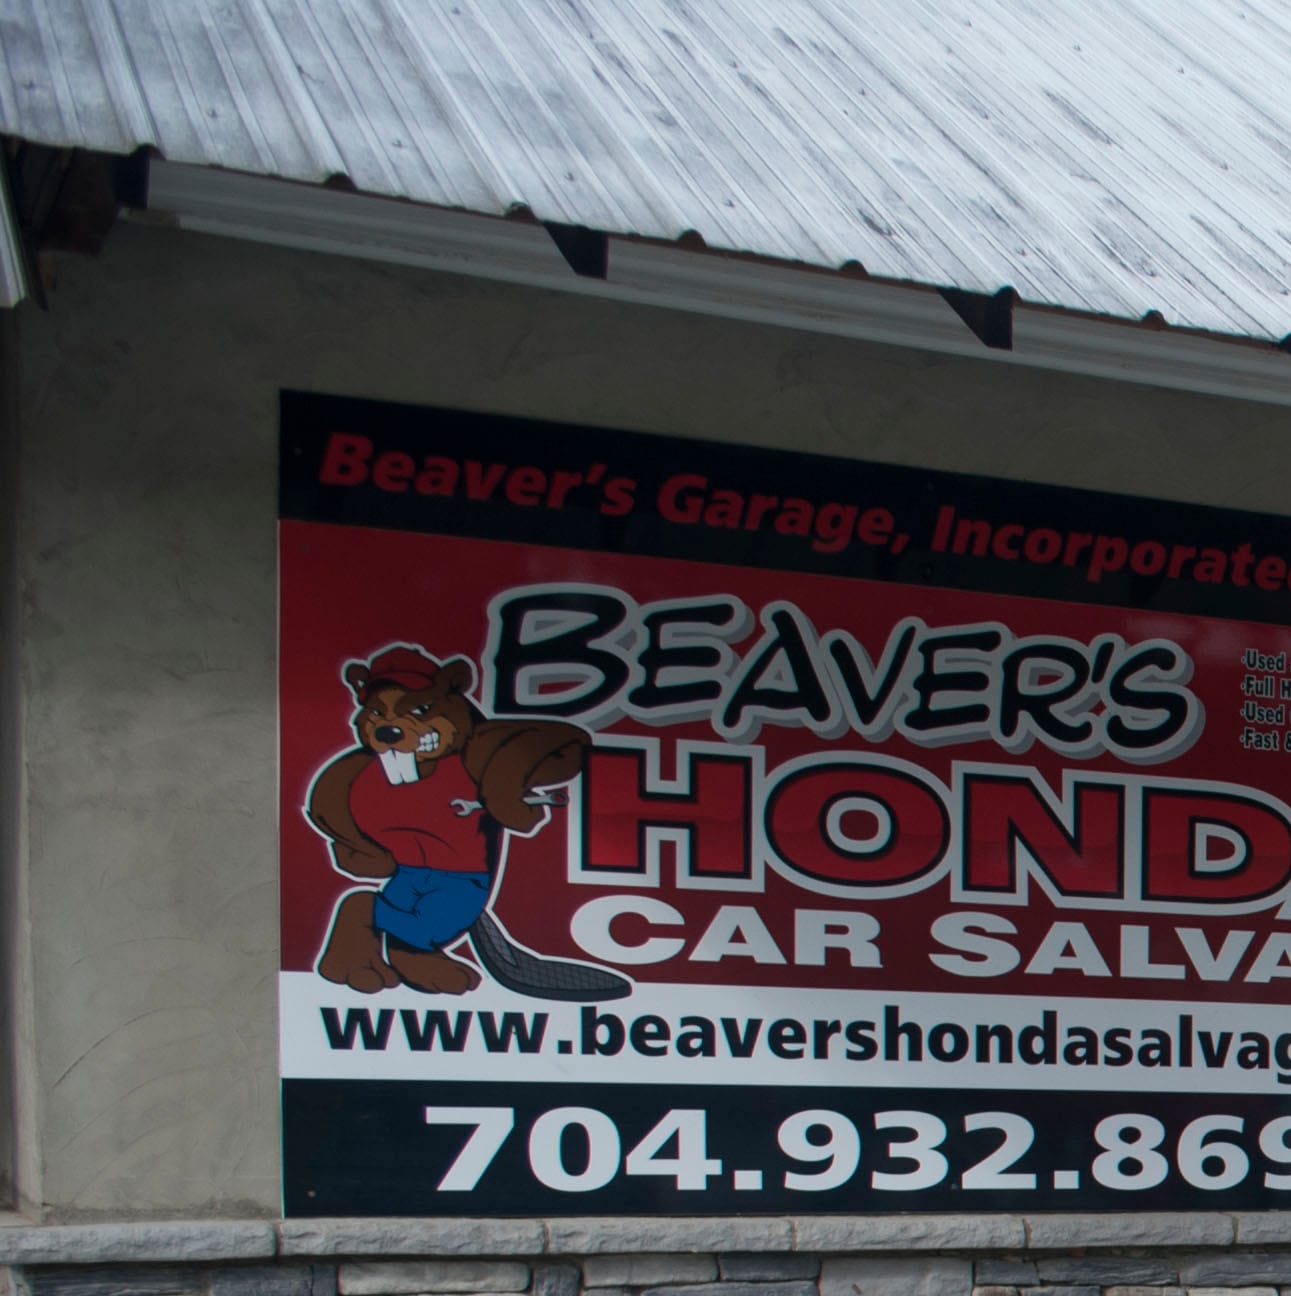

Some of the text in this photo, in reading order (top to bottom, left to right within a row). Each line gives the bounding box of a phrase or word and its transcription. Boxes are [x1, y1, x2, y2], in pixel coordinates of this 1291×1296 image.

[319, 432, 637, 516] Beaver's
[656, 473, 910, 555] Garage,
[485, 586, 1199, 752] BEAVER'S
[570, 894, 883, 968] CAR
